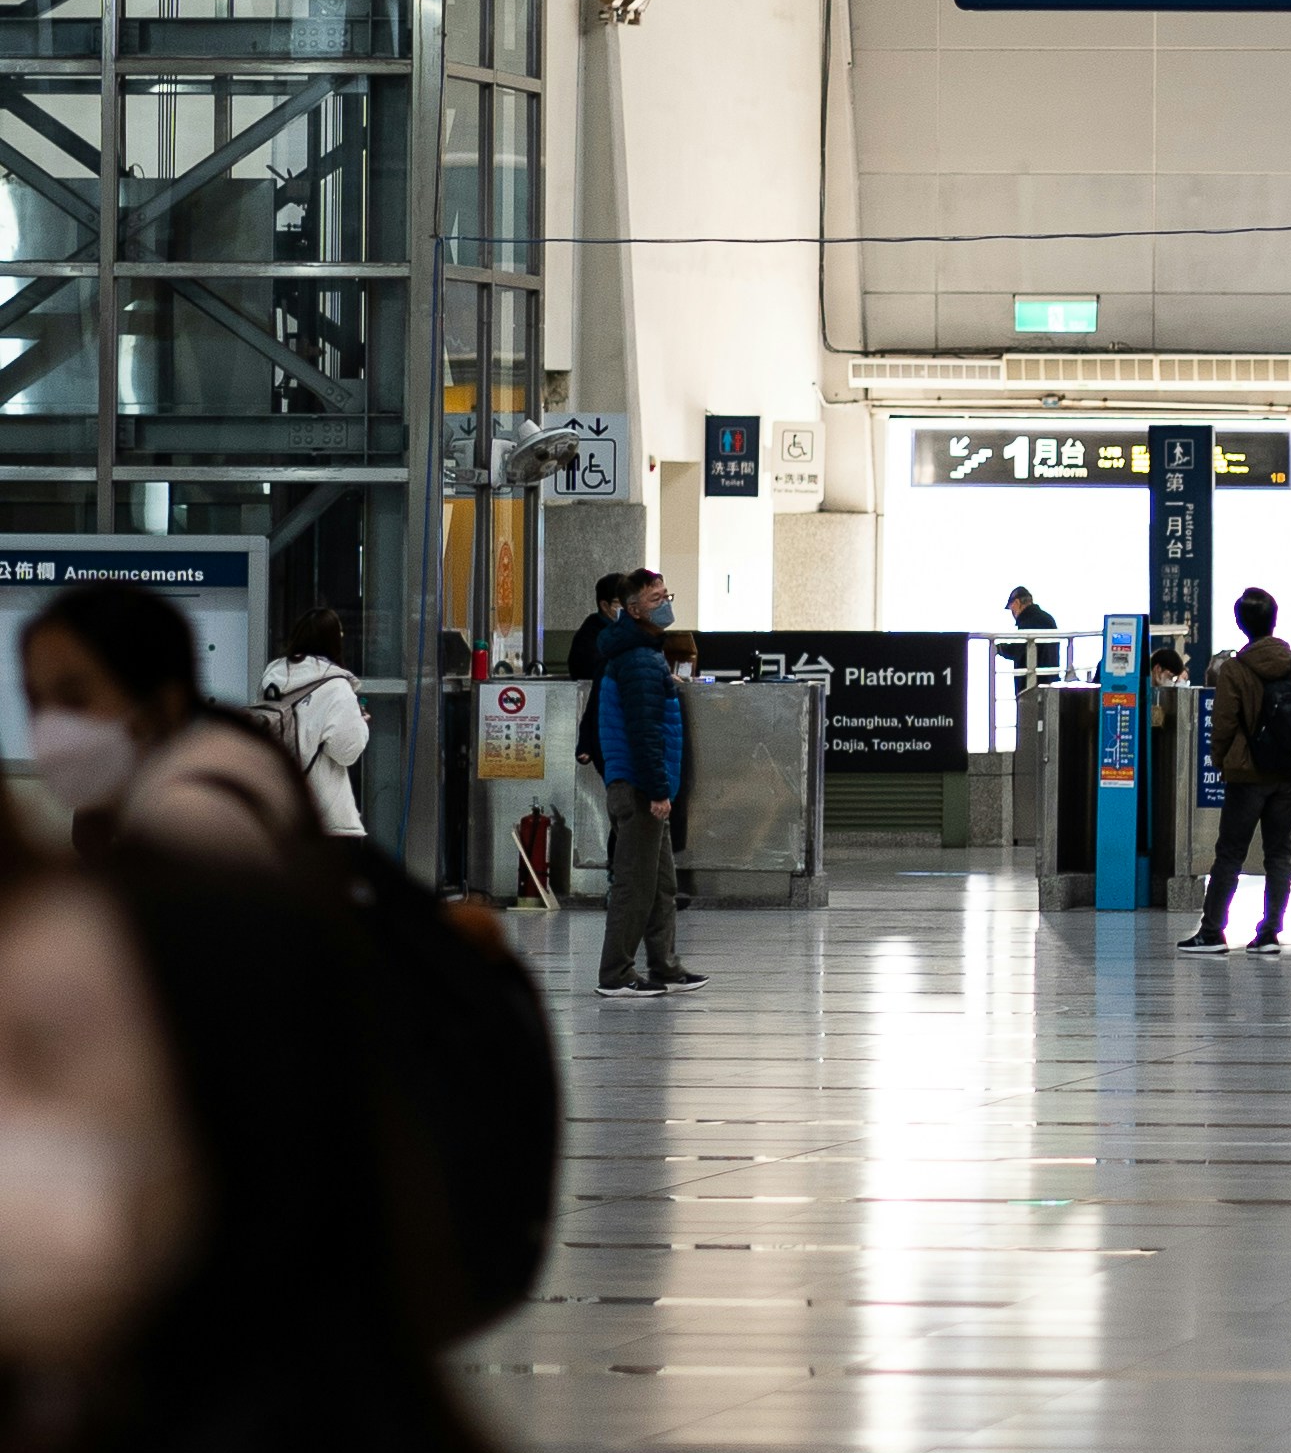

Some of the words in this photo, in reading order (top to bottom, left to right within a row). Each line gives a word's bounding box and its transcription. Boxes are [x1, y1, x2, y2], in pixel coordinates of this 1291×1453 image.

[1003, 435, 1030, 480] 1
[1033, 438, 1086, 466] 月台
[711, 460, 755, 475] 洗手間
[720, 478, 745, 487] Toilet
[1165, 472, 1184, 559] 第一月台
[1185, 503, 1194, 550] Platform
[64, 566, 205, 582] Announcements
[845, 667, 935, 686] Platform
[942, 667, 953, 686] 1
[832, 715, 902, 730] Changhua,
[905, 715, 954, 727] Yuanlin
[832, 738, 869, 752] Dajia,
[871, 738, 932, 752] Tongxiao
